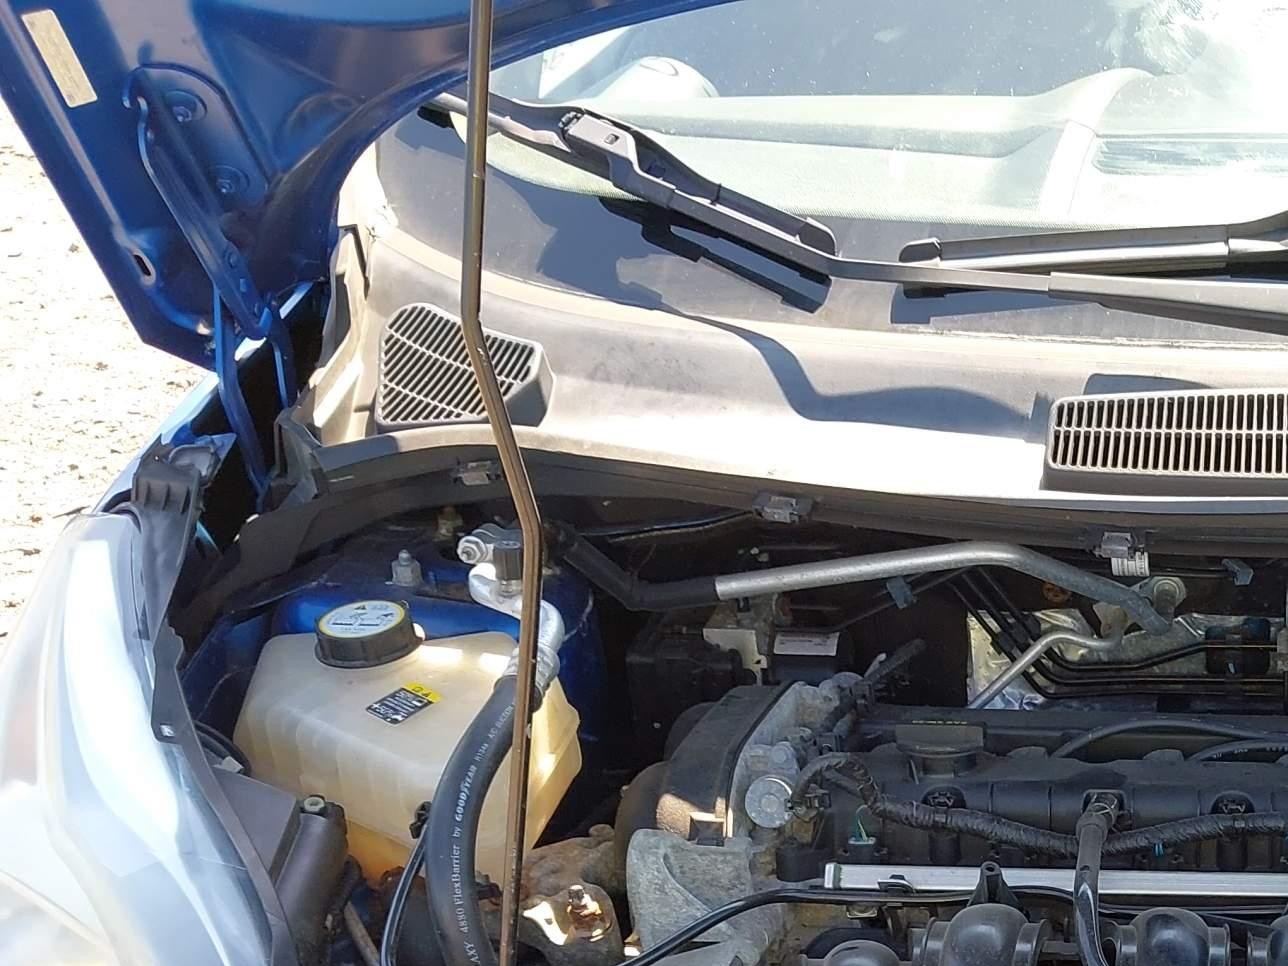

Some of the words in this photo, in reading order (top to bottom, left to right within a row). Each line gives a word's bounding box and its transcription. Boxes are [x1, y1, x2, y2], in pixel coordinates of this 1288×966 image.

[455, 764, 478, 822] GOODYEAR
[452, 826, 463, 838] by
[450, 844, 464, 907] FlexBarrier
